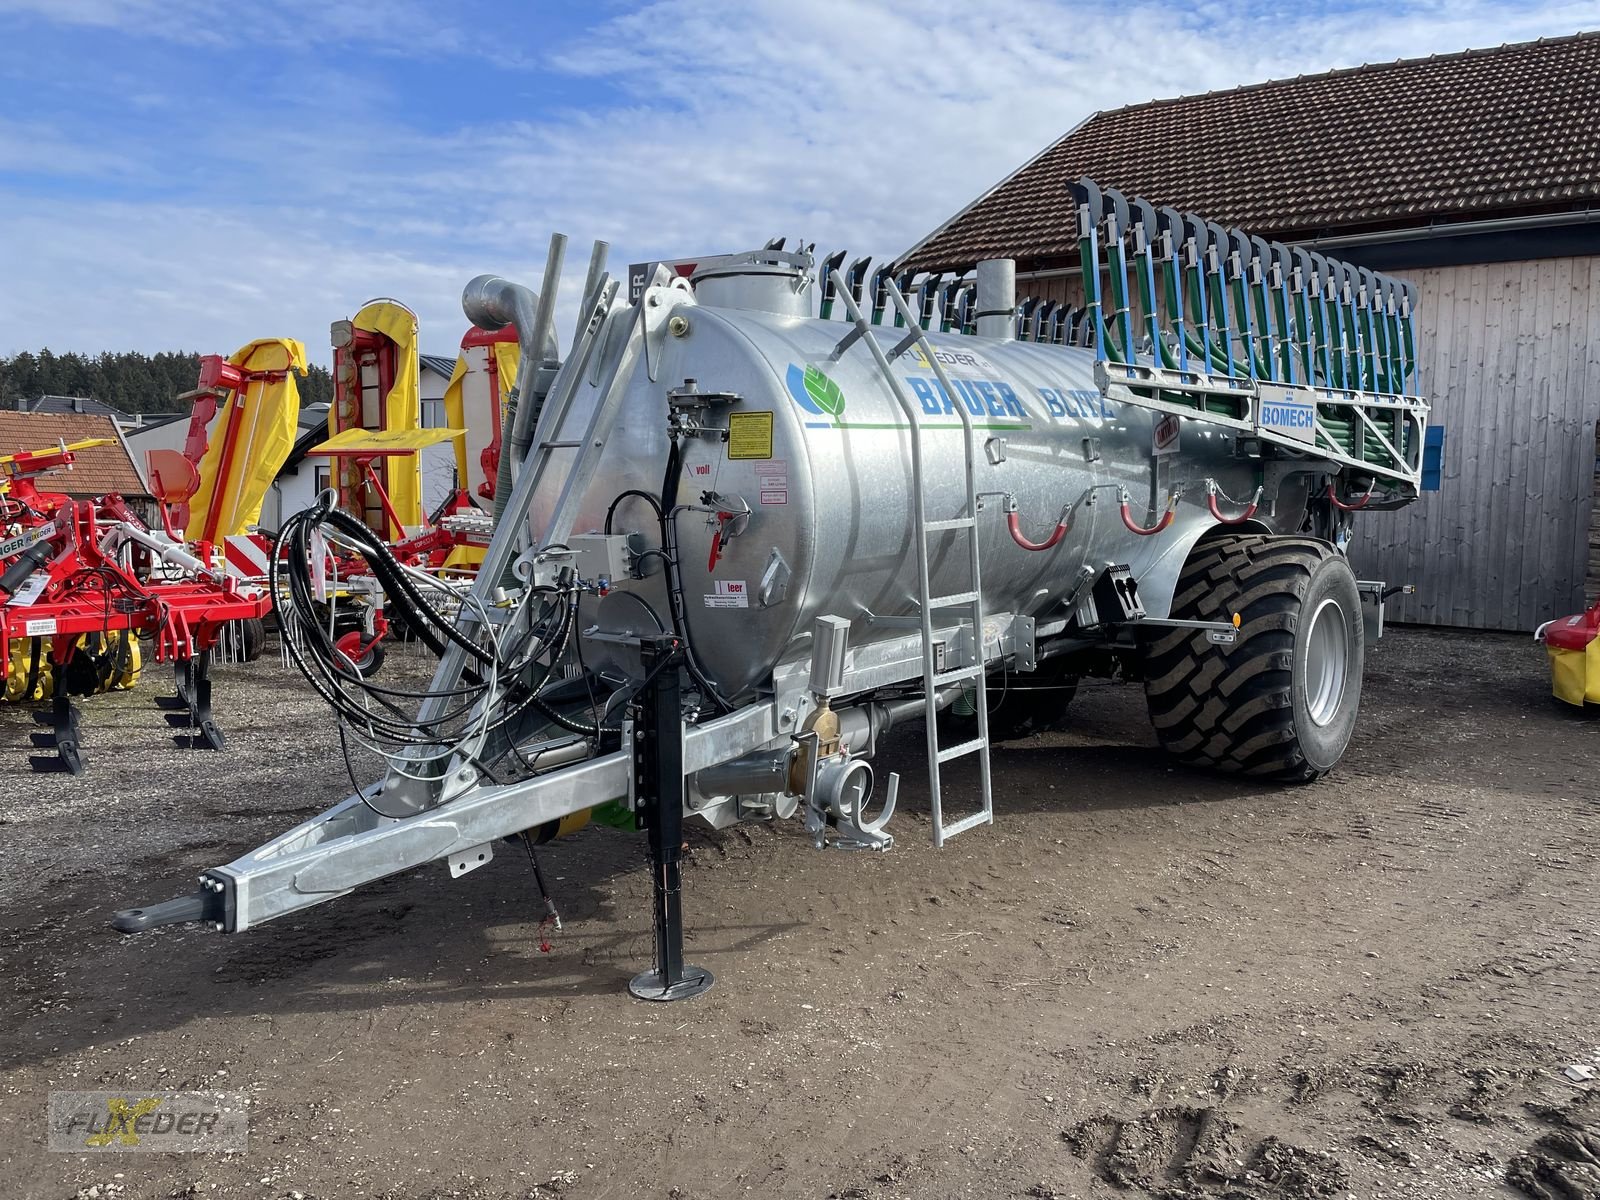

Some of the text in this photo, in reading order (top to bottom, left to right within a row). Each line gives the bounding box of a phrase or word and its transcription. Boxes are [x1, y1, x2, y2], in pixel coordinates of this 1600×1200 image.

[905, 376, 1027, 417] BAUER
[1038, 388, 1115, 418] BLITZ
[1262, 406, 1313, 428] BOMECH
[696, 464, 710, 475] voll
[727, 582, 743, 593] leer
